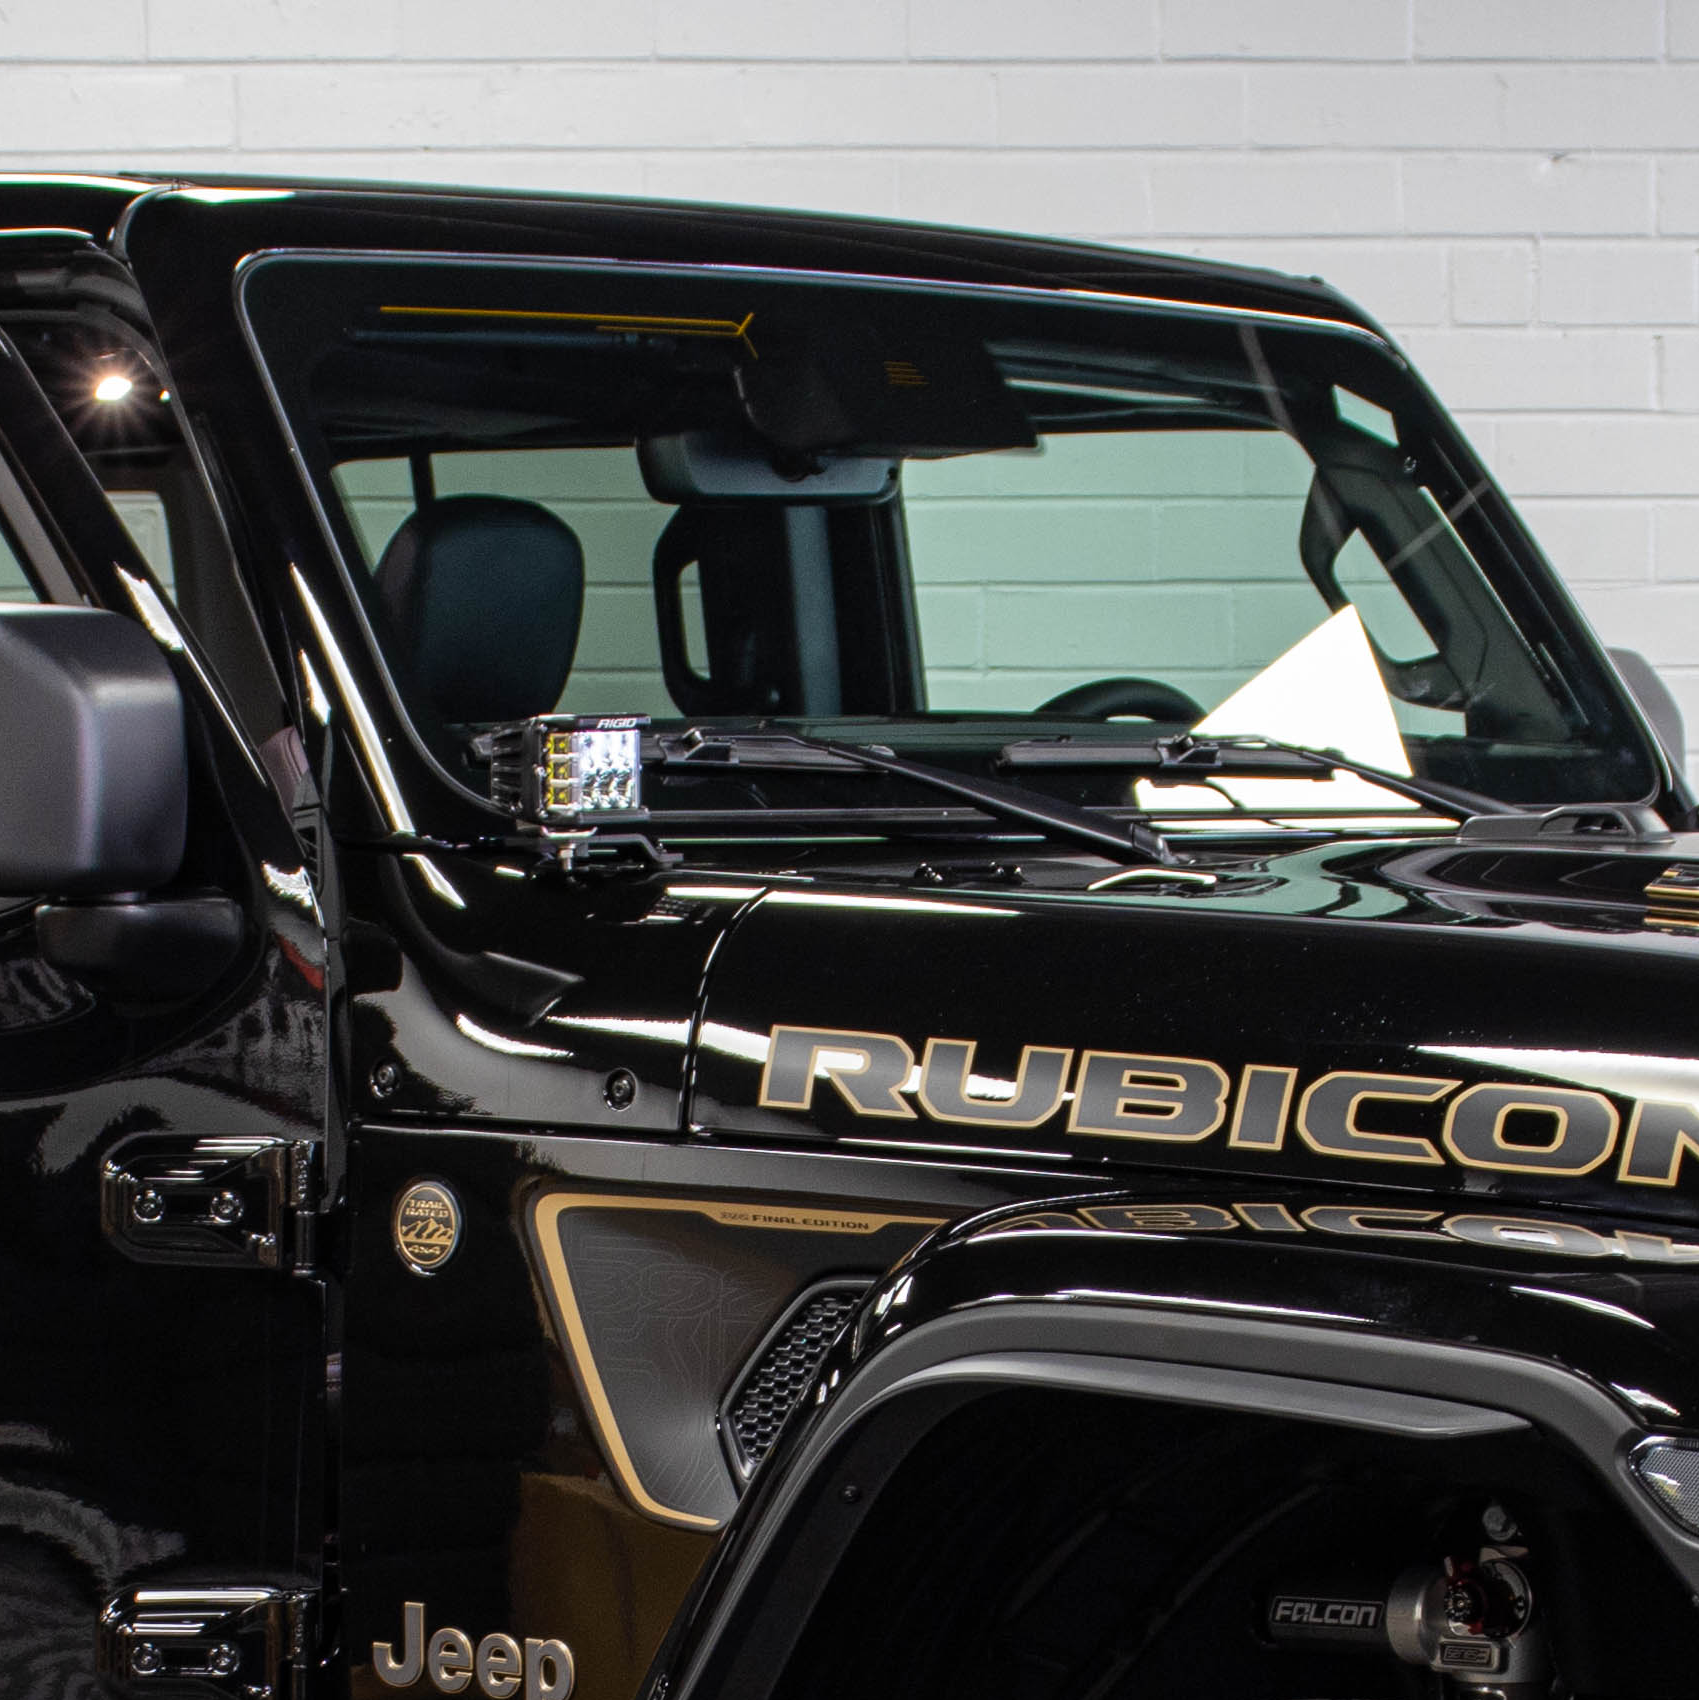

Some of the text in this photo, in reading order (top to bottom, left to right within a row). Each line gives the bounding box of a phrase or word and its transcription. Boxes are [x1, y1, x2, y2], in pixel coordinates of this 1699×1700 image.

[596, 717, 637, 729] RIGID
[406, 1199, 446, 1209] TRAIL
[405, 1207, 450, 1218] RATED
[751, 1214, 796, 1224] FINAL
[802, 1218, 869, 1231] EDITION
[1275, 1601, 1377, 1627] FALCON
